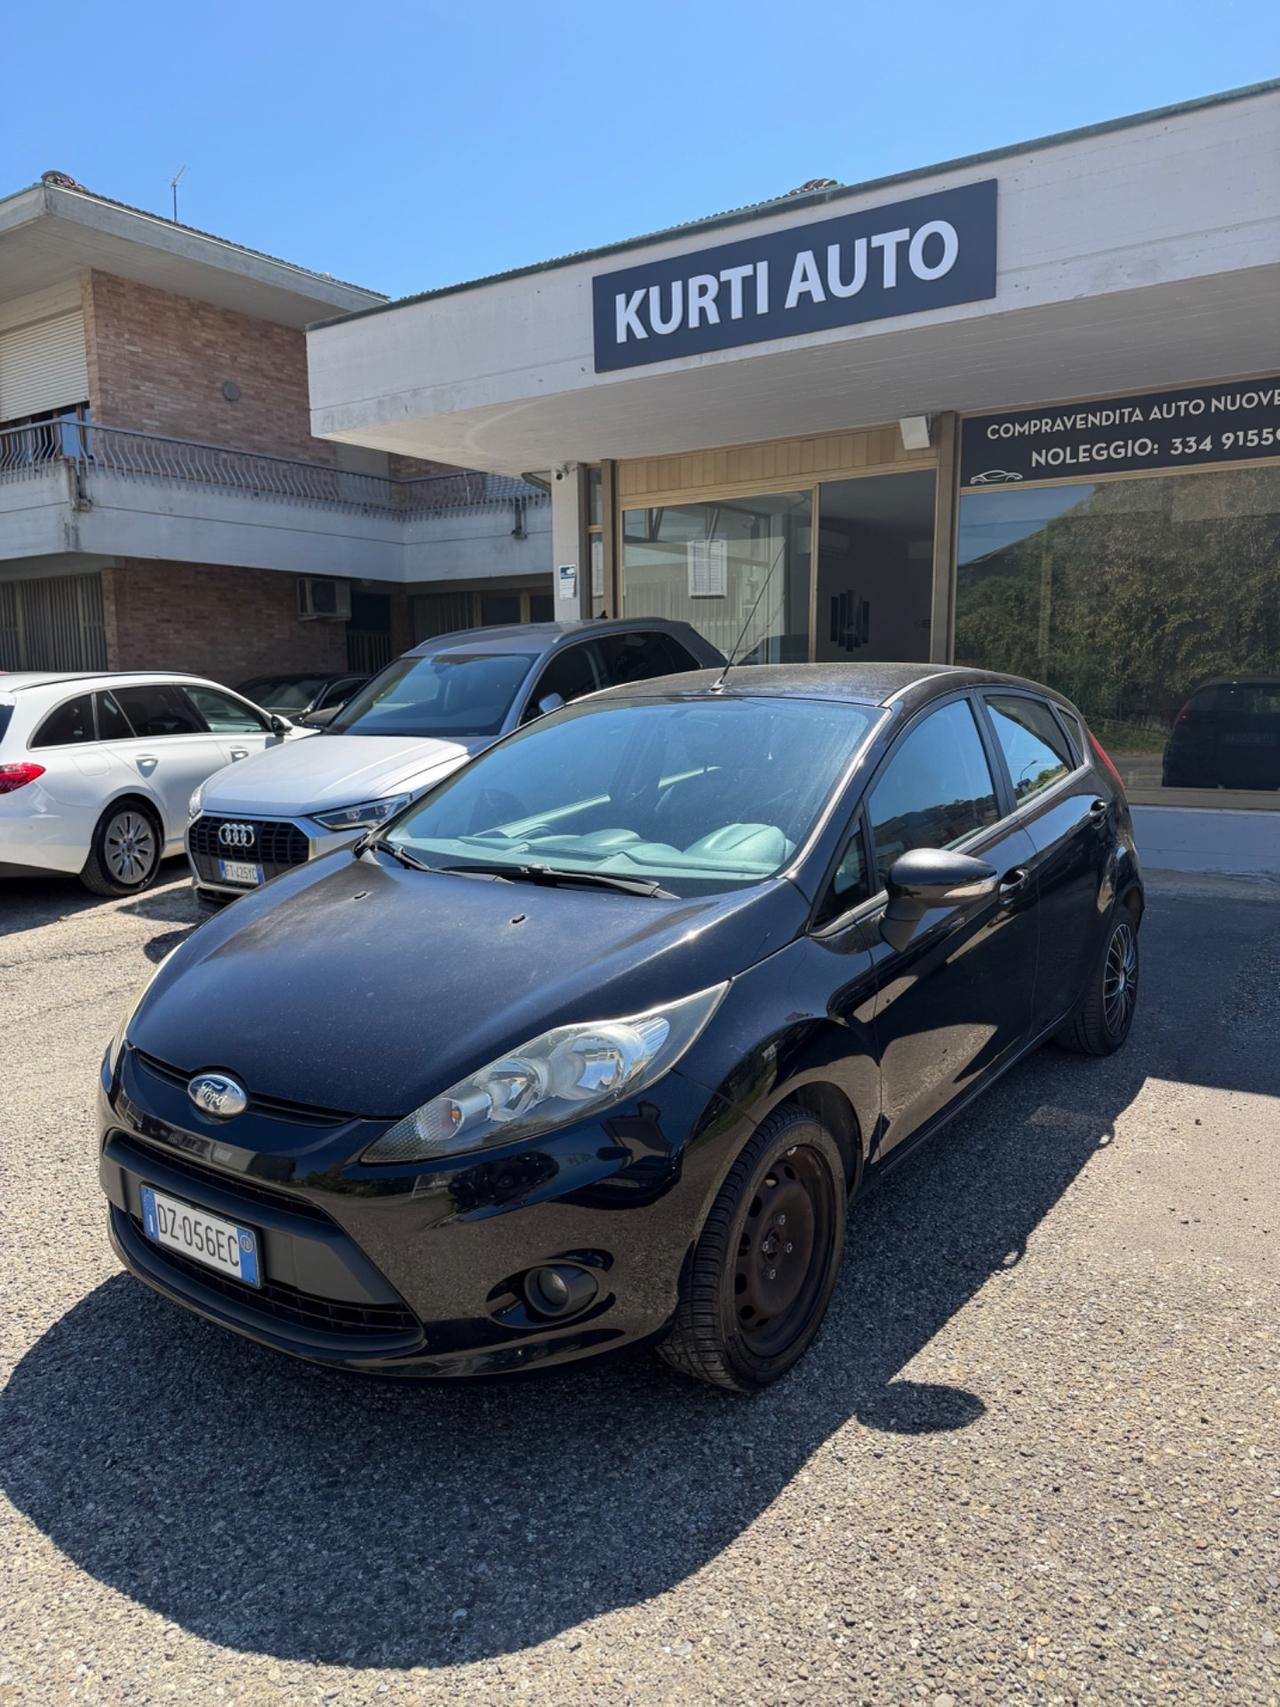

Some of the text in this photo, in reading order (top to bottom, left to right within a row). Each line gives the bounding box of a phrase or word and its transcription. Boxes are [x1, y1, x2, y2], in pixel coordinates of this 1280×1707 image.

[616, 220, 960, 344] KURTI AUTO
[987, 389, 1280, 440] COMPRAVENDITA AUTO NUOVE
[1031, 437, 1159, 468] NOLEGGIO:
[1170, 434, 1213, 456] 334
[199, 1080, 229, 1106] Ford
